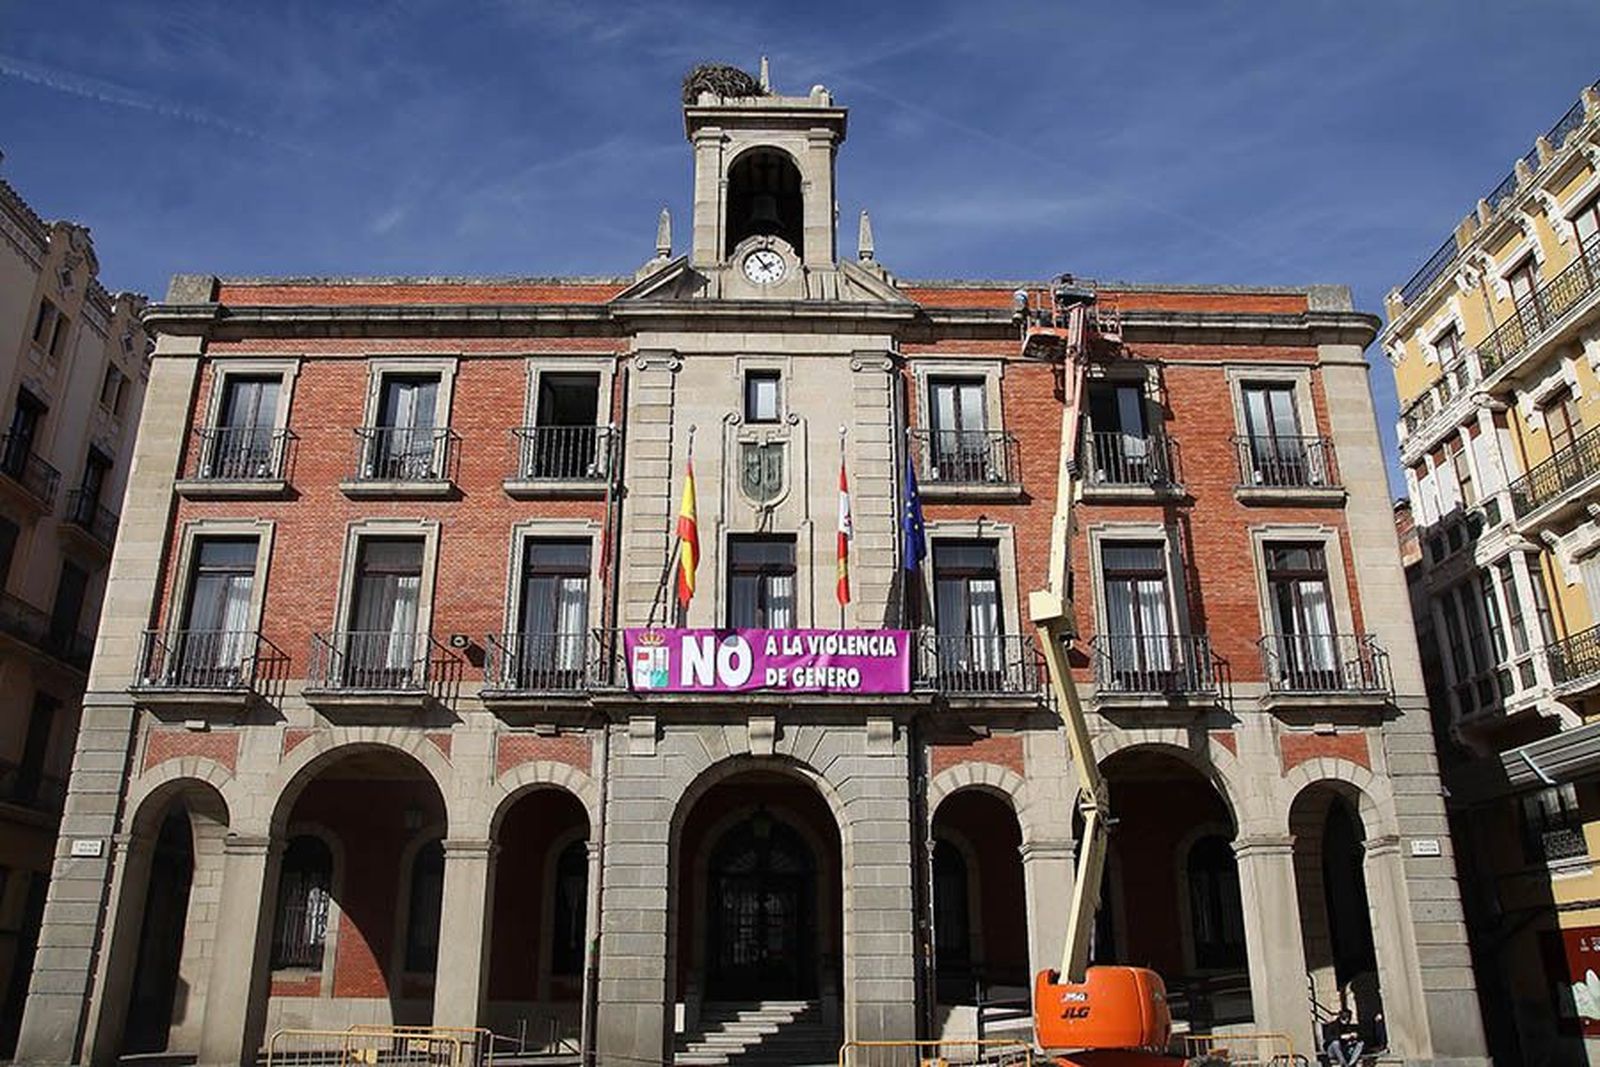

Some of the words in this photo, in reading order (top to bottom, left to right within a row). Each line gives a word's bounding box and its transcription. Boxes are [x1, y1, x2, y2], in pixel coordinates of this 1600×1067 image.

[765, 636, 777, 655] A
[783, 636, 803, 656] LA
[807, 635, 896, 656] VIOLENCIA
[681, 635, 753, 687] NO
[766, 668, 787, 687] DE
[792, 662, 860, 688] GÉNERO
[1061, 1007, 1090, 1019] JLG
